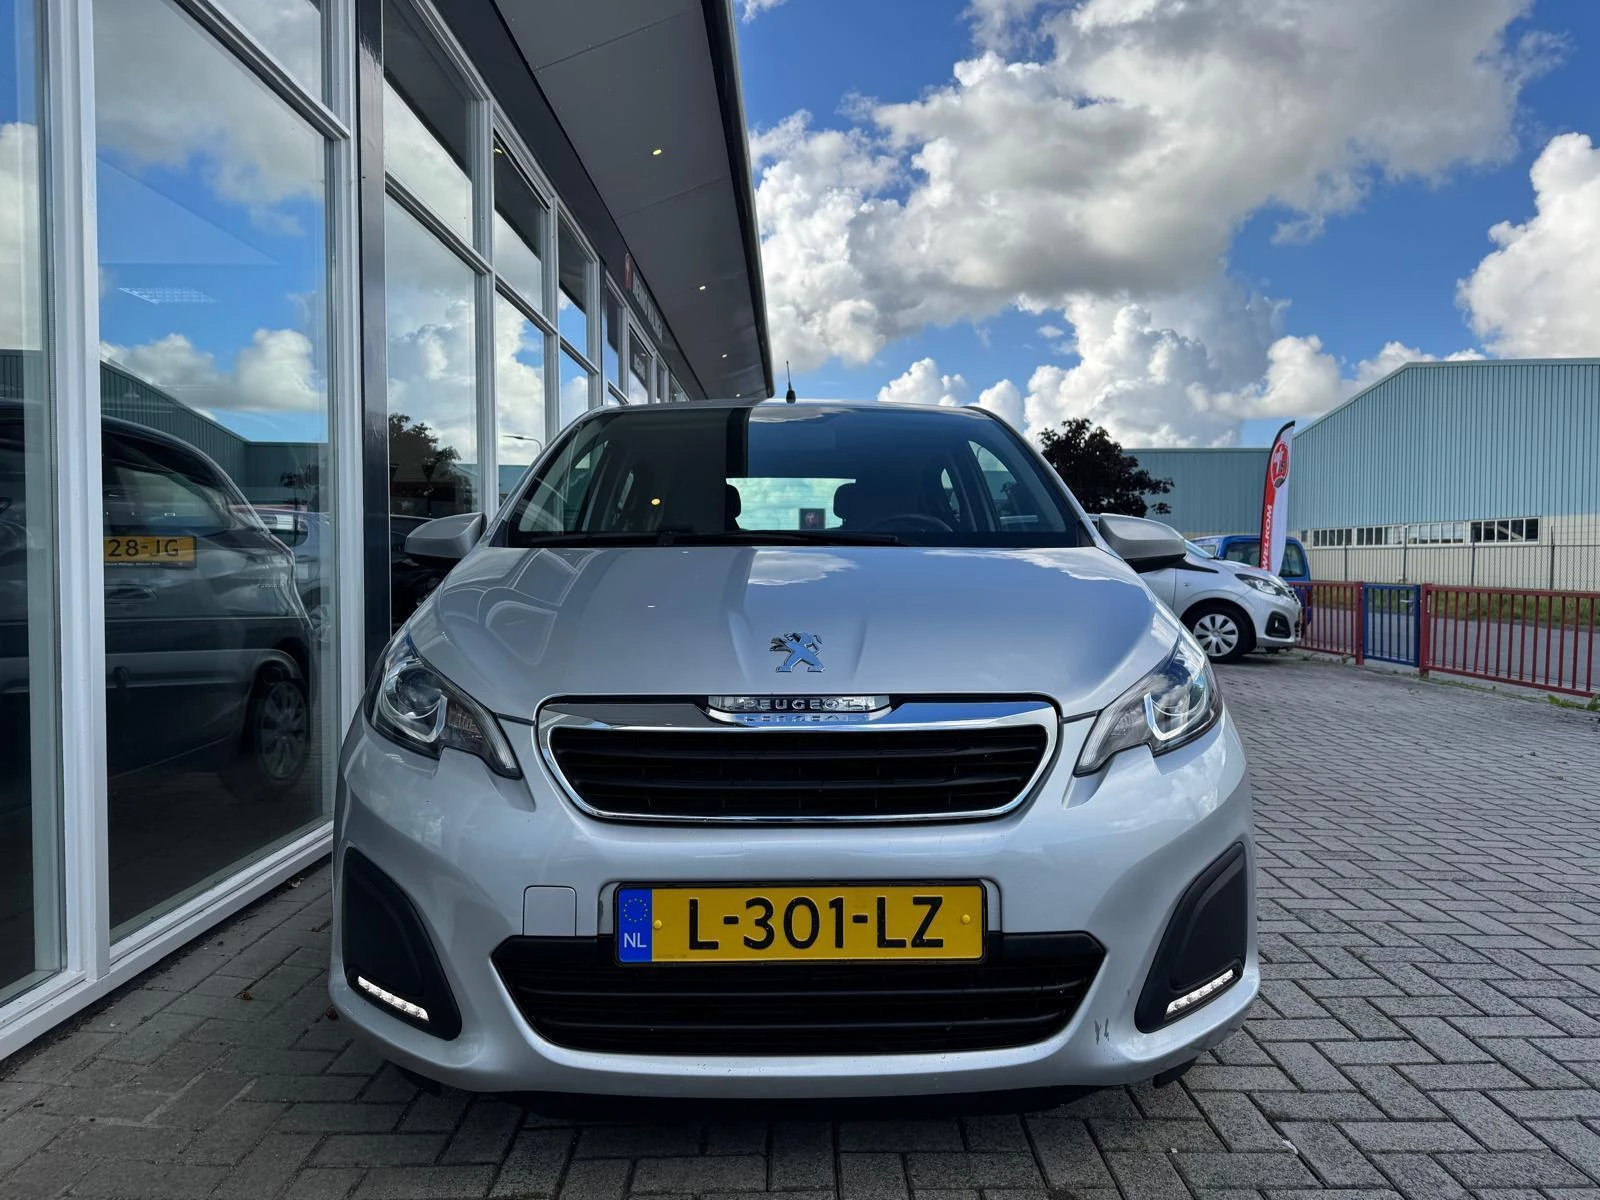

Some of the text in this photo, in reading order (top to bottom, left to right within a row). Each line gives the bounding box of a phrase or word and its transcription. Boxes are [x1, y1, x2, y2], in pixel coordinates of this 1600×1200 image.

[1262, 504, 1273, 570] WELKOM
[743, 697, 856, 711] PEUGEOT
[623, 932, 647, 948] NL
[689, 896, 944, 950] L-301-LZ
